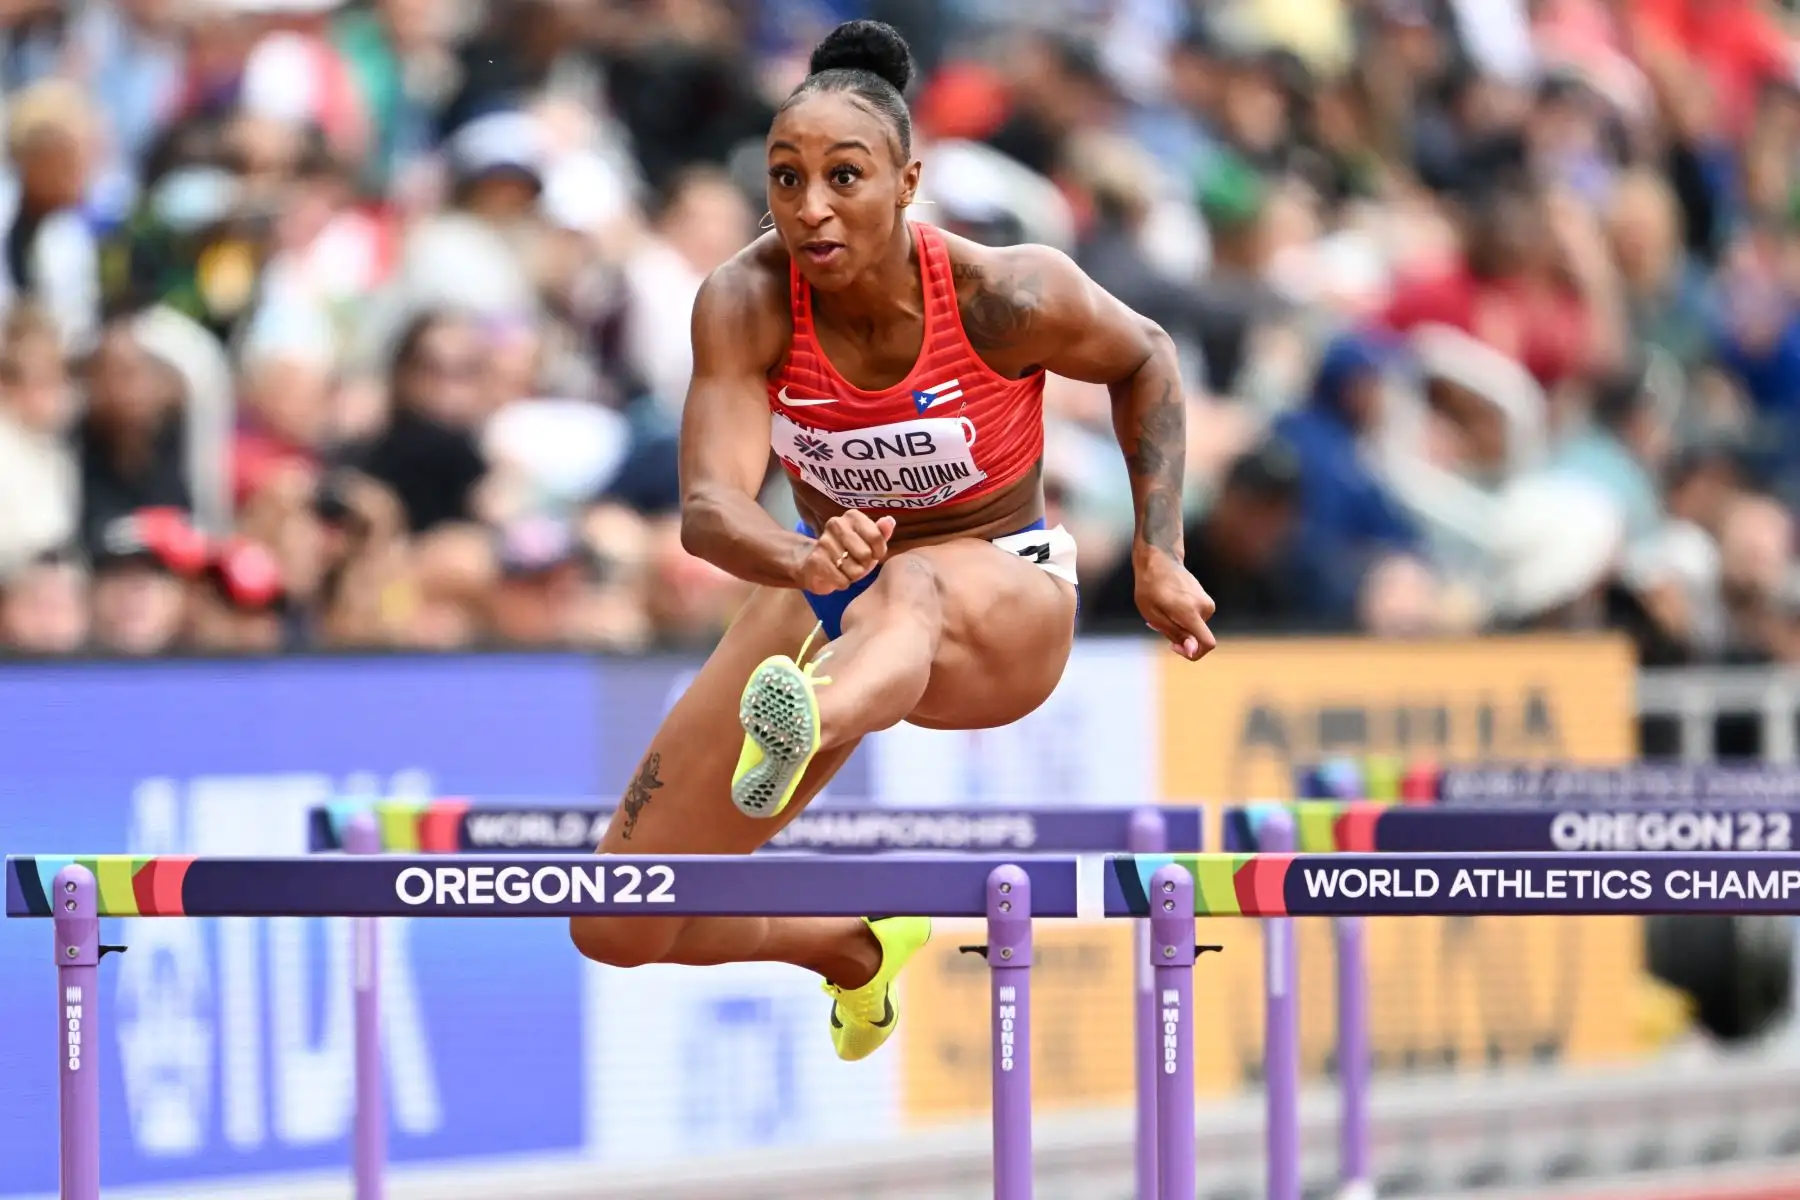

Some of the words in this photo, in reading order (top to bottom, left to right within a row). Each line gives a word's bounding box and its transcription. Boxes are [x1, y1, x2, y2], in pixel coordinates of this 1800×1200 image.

[841, 431, 937, 461] QNB
[783, 455, 971, 493] MACHO-QUINN
[825, 485, 957, 509] REGON22
[1303, 868, 1440, 899] WORLD
[1448, 869, 1653, 899] ATHLETICS
[1664, 869, 1800, 900] CHAMP
[66, 1005, 82, 1071] MONDO
[999, 1005, 1016, 1071] MONDO
[1162, 1008, 1179, 1074] MONDO
